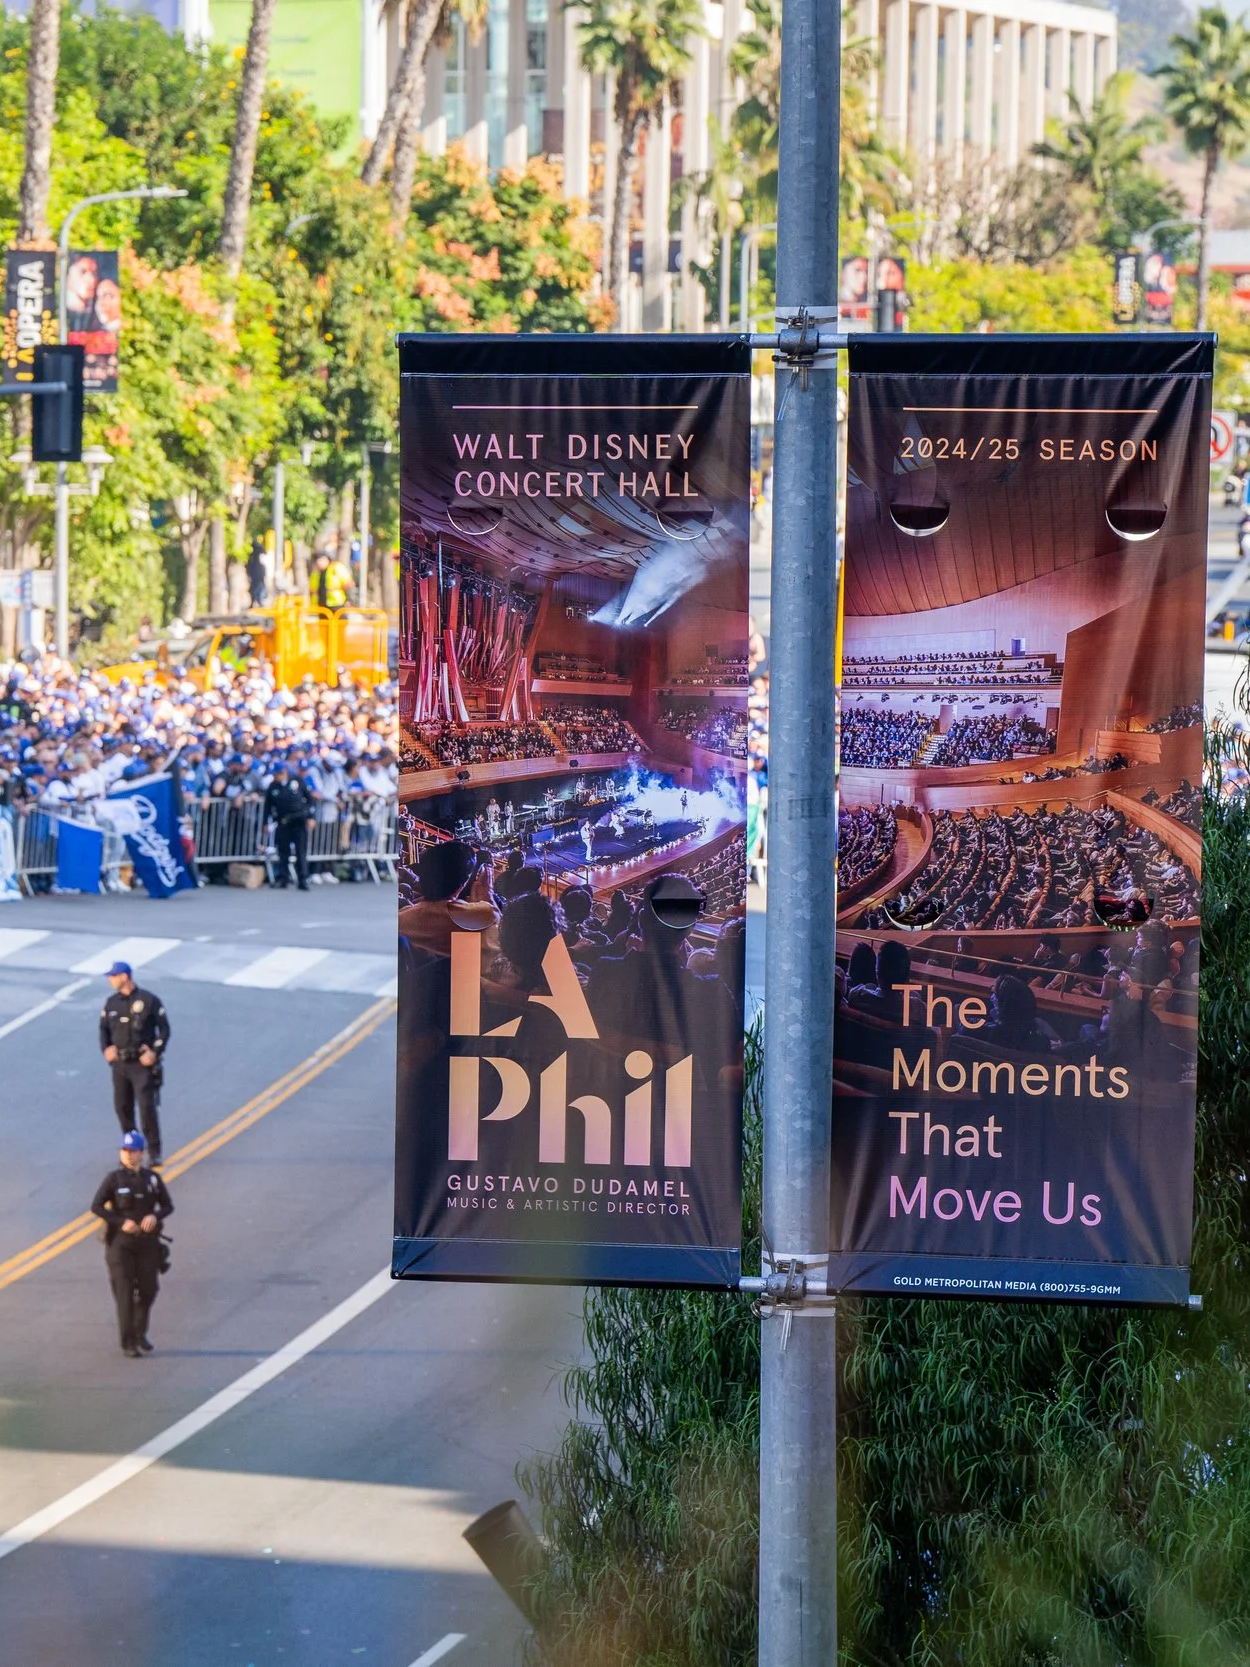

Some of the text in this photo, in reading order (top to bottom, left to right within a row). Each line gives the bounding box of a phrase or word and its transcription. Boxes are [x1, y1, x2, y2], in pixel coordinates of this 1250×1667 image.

[16, 260, 45, 348] OPERA
[453, 434, 695, 460] WALT DISNEY
[901, 437, 1157, 461] 2024/25 SEASON
[454, 471, 699, 497] CONCERT HALL
[450, 932, 600, 1039] LA
[891, 983, 987, 1029] The
[892, 1048, 1130, 1099] Moments
[448, 1050, 693, 1167] Phil
[888, 1112, 1002, 1158] That
[447, 1175, 690, 1198] GUSTAVO DUDAMEL
[447, 1197, 690, 1215] MUSIC & ARTISTIC DIRECTOR
[889, 1175, 1102, 1227] Move Us
[893, 1276, 1121, 1295] GOLD METROPOLITAN MEDIA (800)755-9GMM
